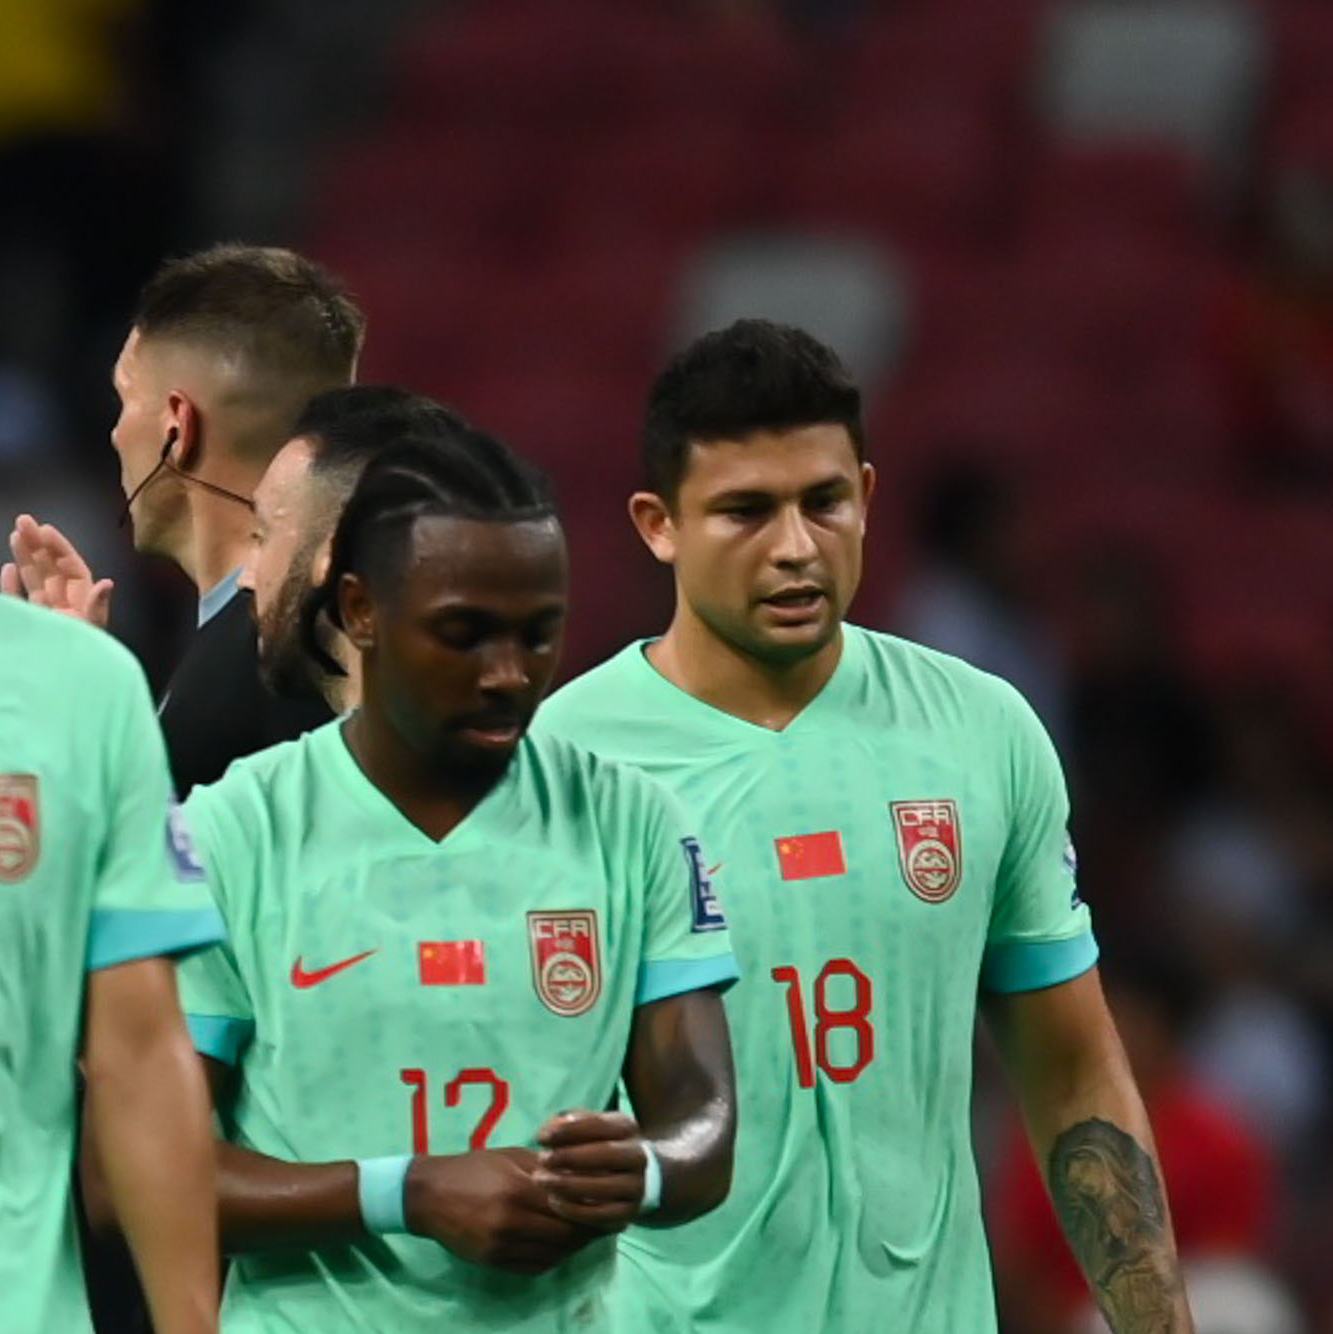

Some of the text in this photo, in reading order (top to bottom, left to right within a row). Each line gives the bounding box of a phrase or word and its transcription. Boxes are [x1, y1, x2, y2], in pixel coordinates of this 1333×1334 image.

[898, 809, 952, 827] CFA
[535, 919, 590, 938] CFA
[771, 957, 875, 1089] 18
[399, 1067, 510, 1157] 12
